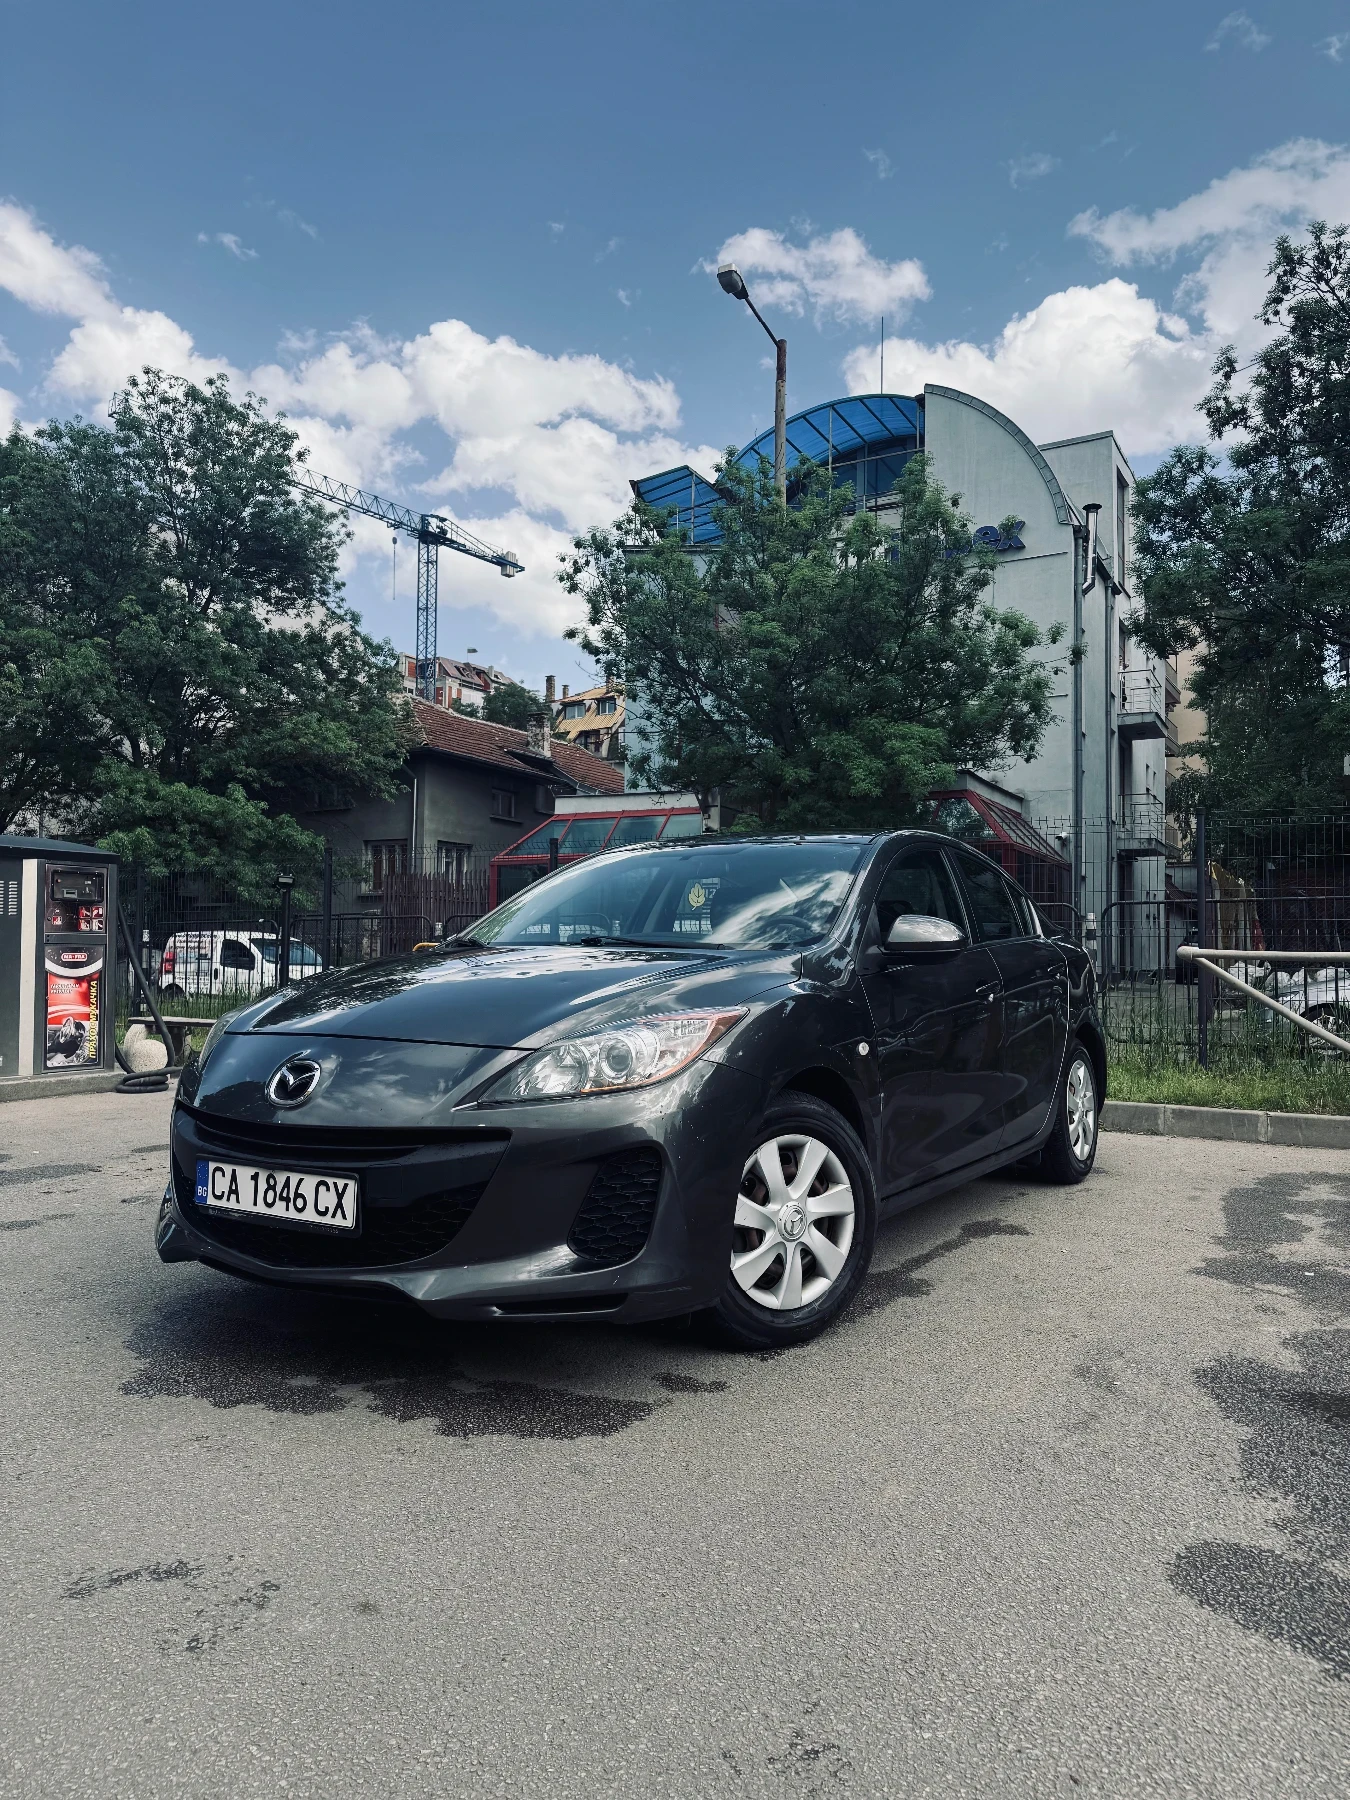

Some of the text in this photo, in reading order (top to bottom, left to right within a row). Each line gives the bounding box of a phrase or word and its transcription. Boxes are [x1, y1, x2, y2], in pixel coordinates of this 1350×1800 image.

[89, 980, 98, 1059] ПРАХОСМУКАЧКА
[197, 1185, 208, 1197] BG
[211, 1166, 350, 1221] CA 1846 CX
